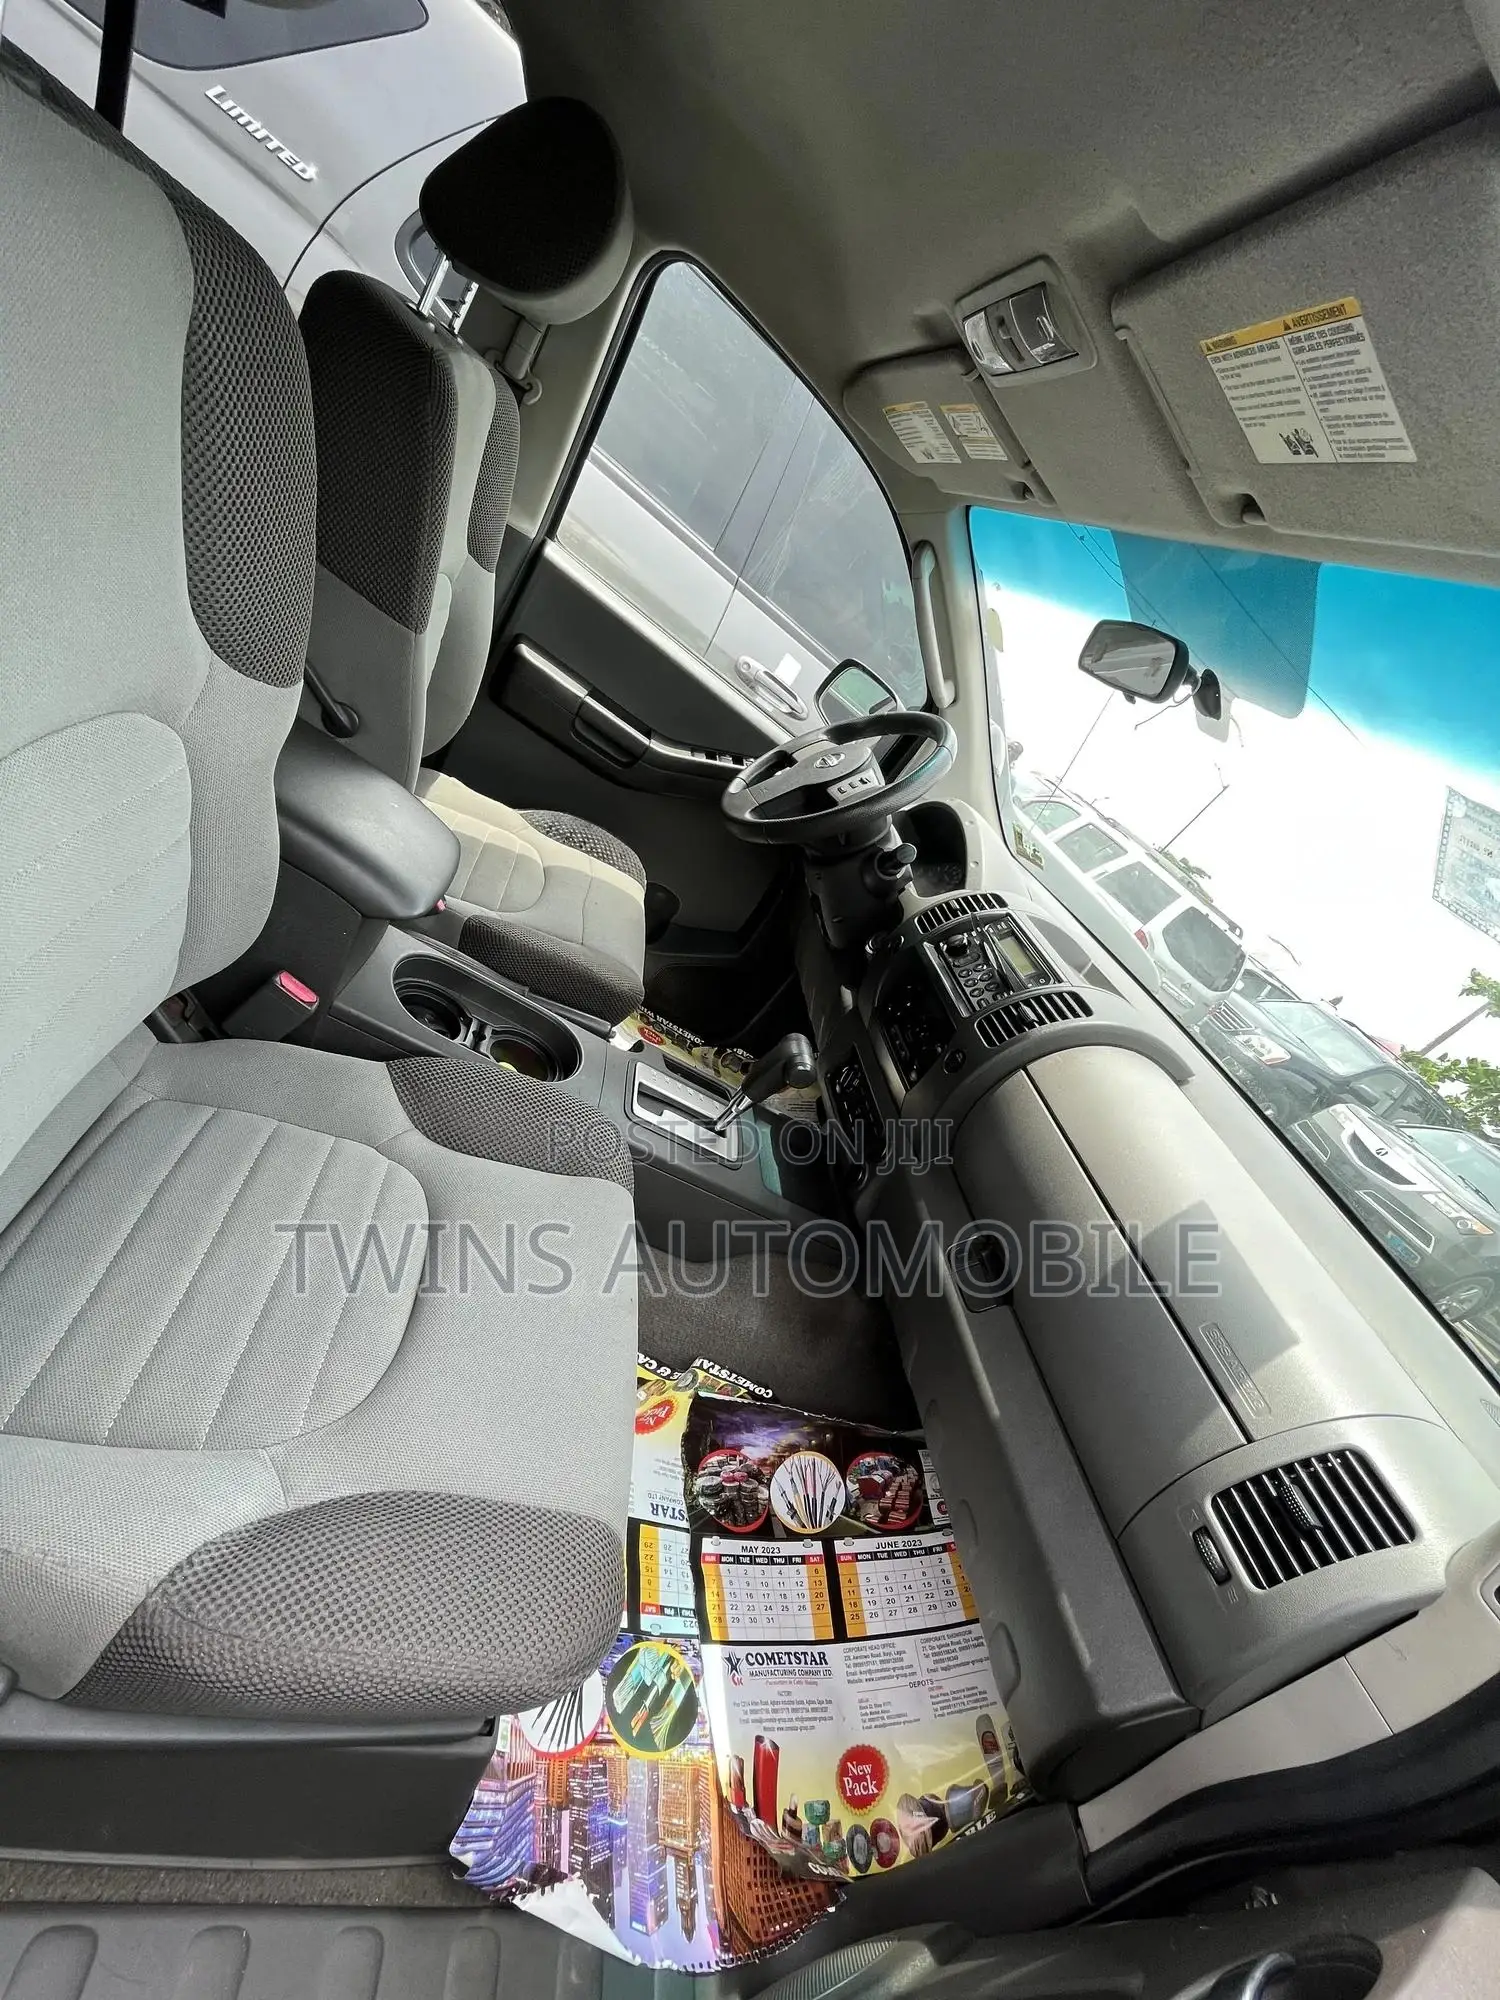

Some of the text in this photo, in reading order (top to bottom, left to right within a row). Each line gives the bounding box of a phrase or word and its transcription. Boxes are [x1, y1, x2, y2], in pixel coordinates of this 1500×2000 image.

[1291, 303, 1347, 328] AVERTISSEMENT
[876, 1540, 923, 1550] JUNE 2023
[745, 1651, 829, 1667] COMETSTAR
[749, 1669, 797, 1678] MANUFACTURING
[798, 1669, 821, 1677] COMPANY
[909, 1679, 935, 1689] DEPOTS
[847, 1761, 873, 1778] New
[843, 1776, 879, 1797] Pack
